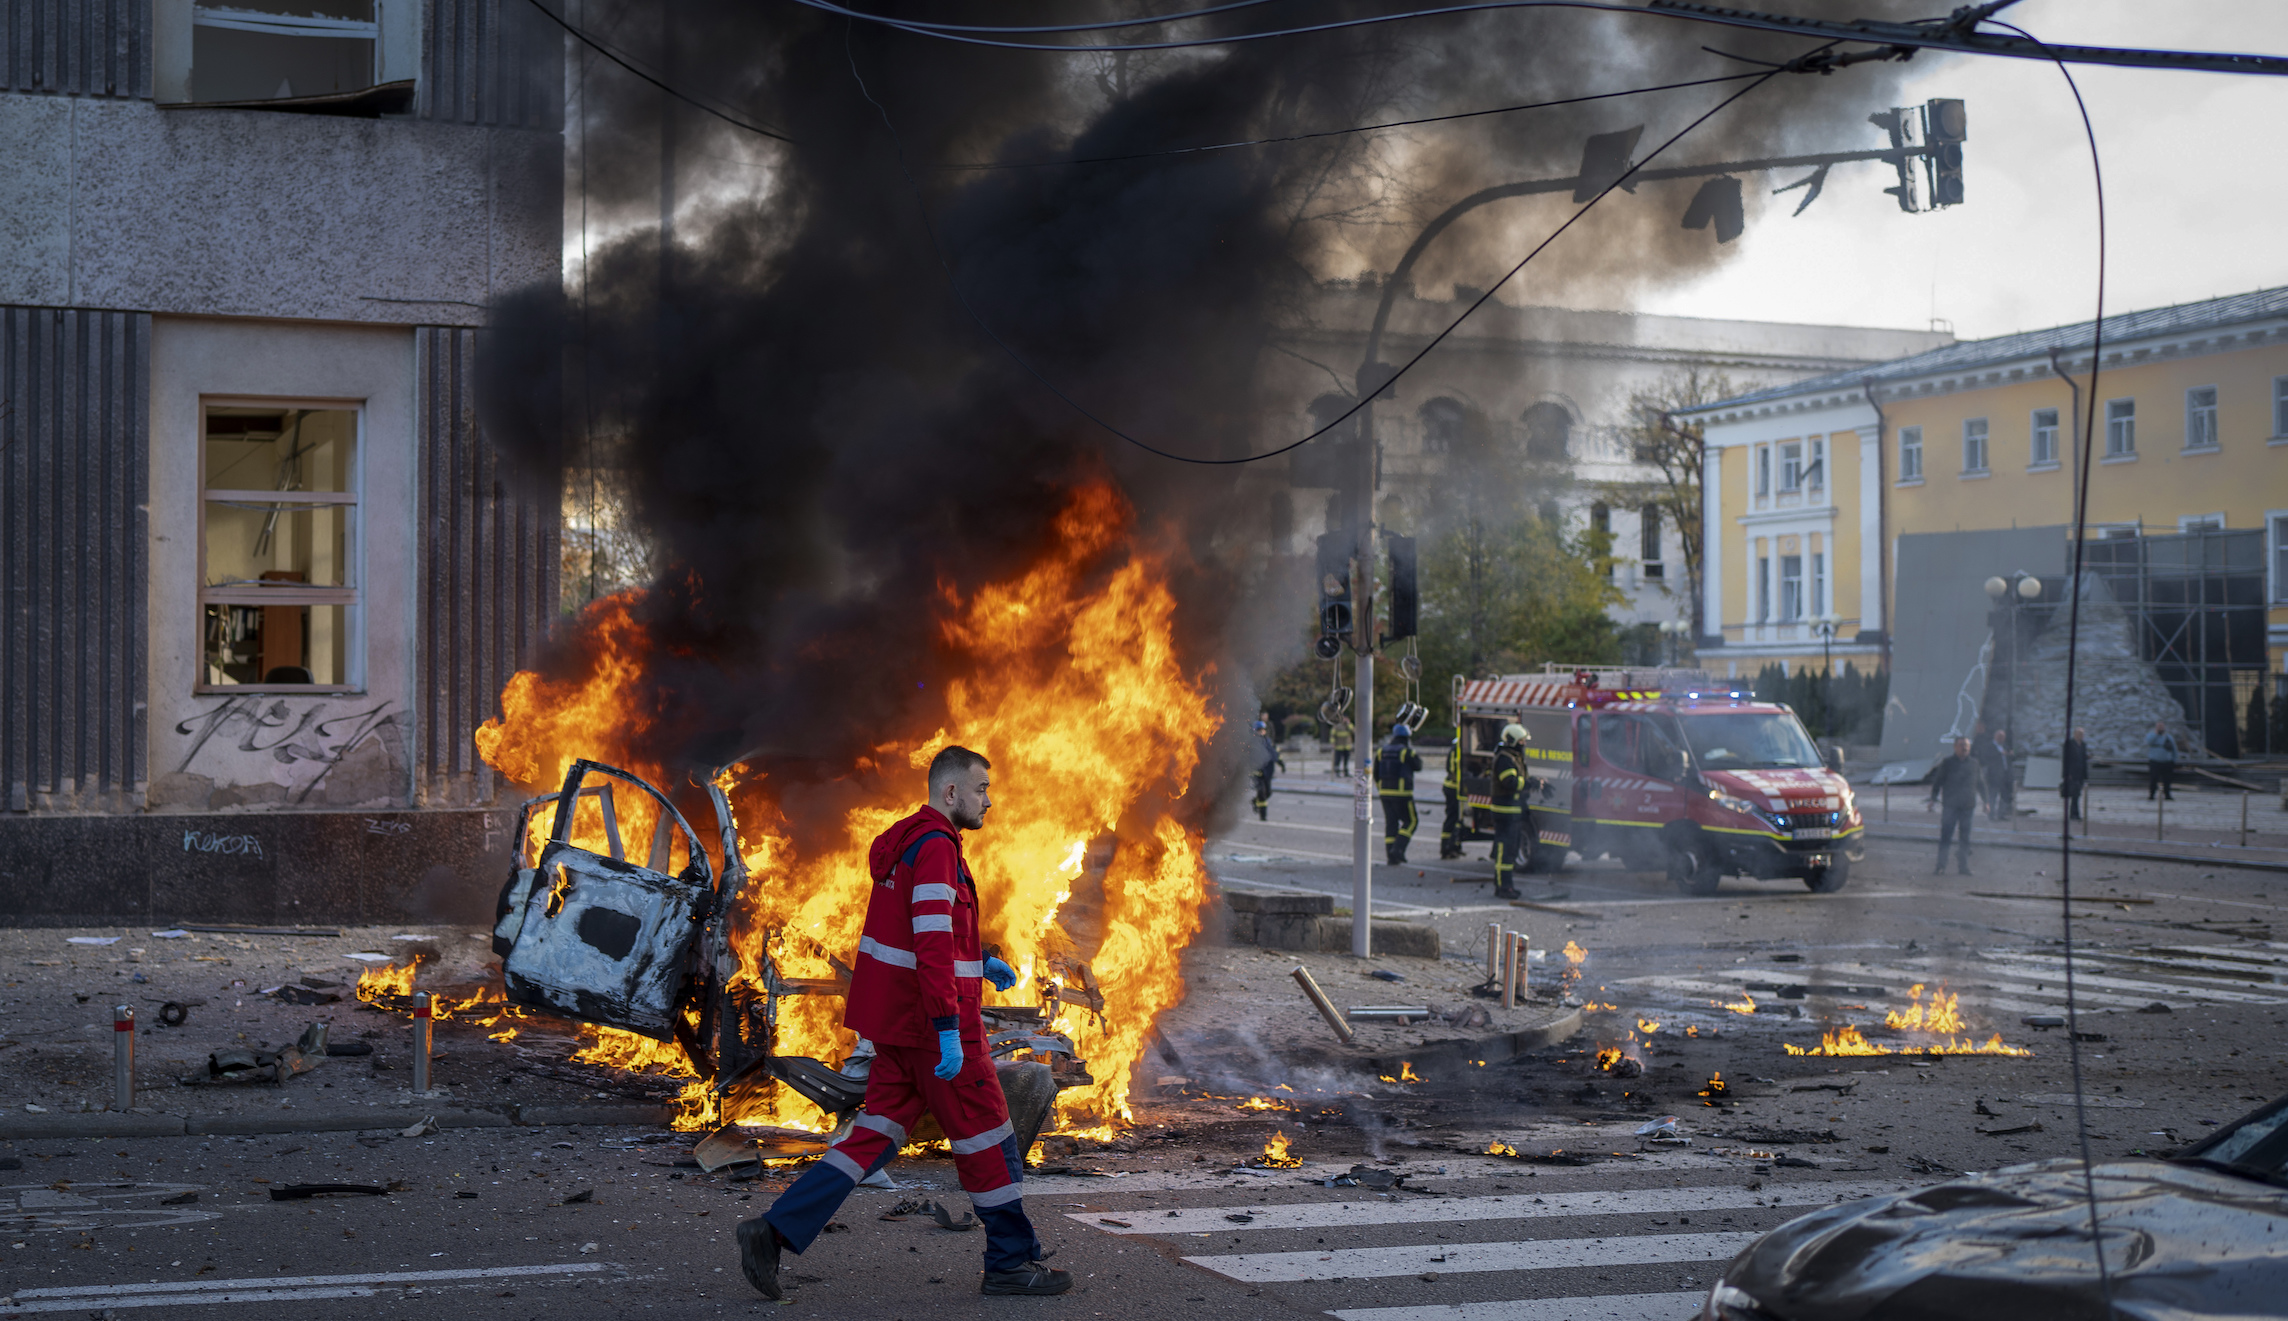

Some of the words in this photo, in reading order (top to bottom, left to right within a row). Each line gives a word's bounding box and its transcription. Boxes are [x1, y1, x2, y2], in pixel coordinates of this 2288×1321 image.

[1525, 747, 1540, 760] FIRE
[1541, 749, 1547, 760] &
[1548, 750, 1573, 762] RESCU
[1789, 798, 1826, 809] IVECO
